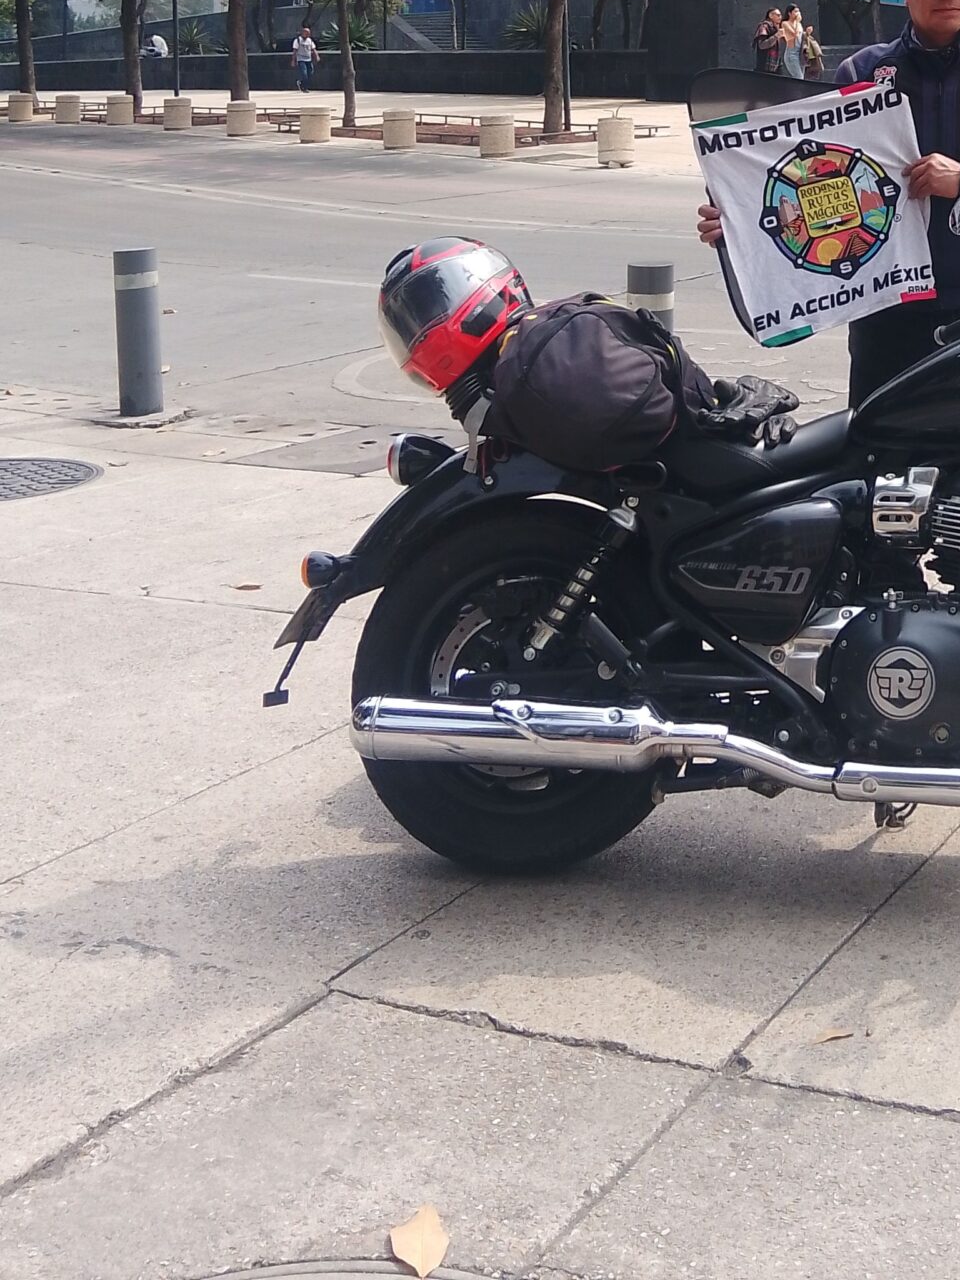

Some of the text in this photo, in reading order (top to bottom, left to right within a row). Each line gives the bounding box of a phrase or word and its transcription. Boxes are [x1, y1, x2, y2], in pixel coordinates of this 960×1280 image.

[698, 89, 902, 155] MOTOTURISMO
[802, 142, 817, 154] N
[883, 185, 896, 197] E
[839, 261, 852, 273] S
[753, 310, 780, 332] EN
[788, 284, 864, 320] ACCIÓN
[736, 565, 811, 594] 650
